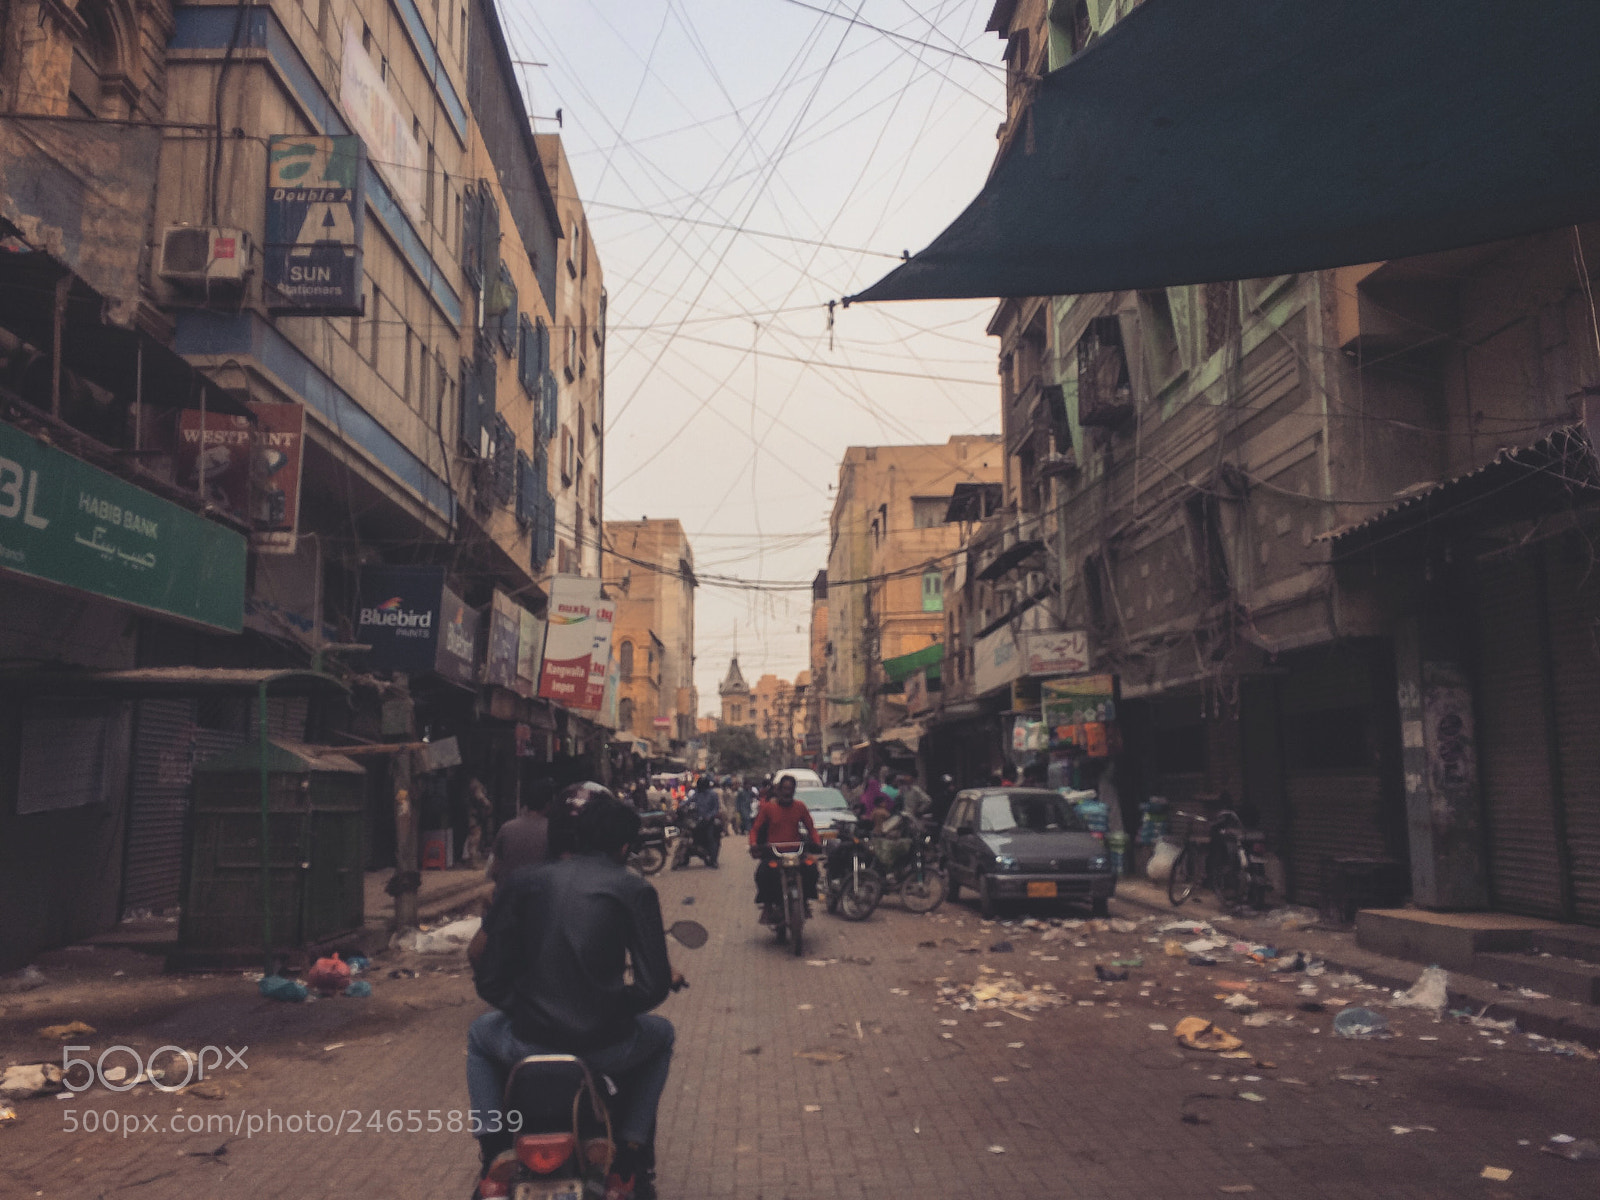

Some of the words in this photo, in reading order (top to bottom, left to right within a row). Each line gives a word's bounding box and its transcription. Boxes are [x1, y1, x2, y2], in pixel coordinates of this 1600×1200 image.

[273, 189, 335, 201] Double
[341, 188, 352, 201] A
[290, 202, 355, 257] A
[290, 266, 331, 282] SUN
[277, 283, 343, 295] Stationers
[79, 491, 122, 525] HABIB
[123, 510, 158, 540] BANK
[360, 608, 432, 628] Bluebird
